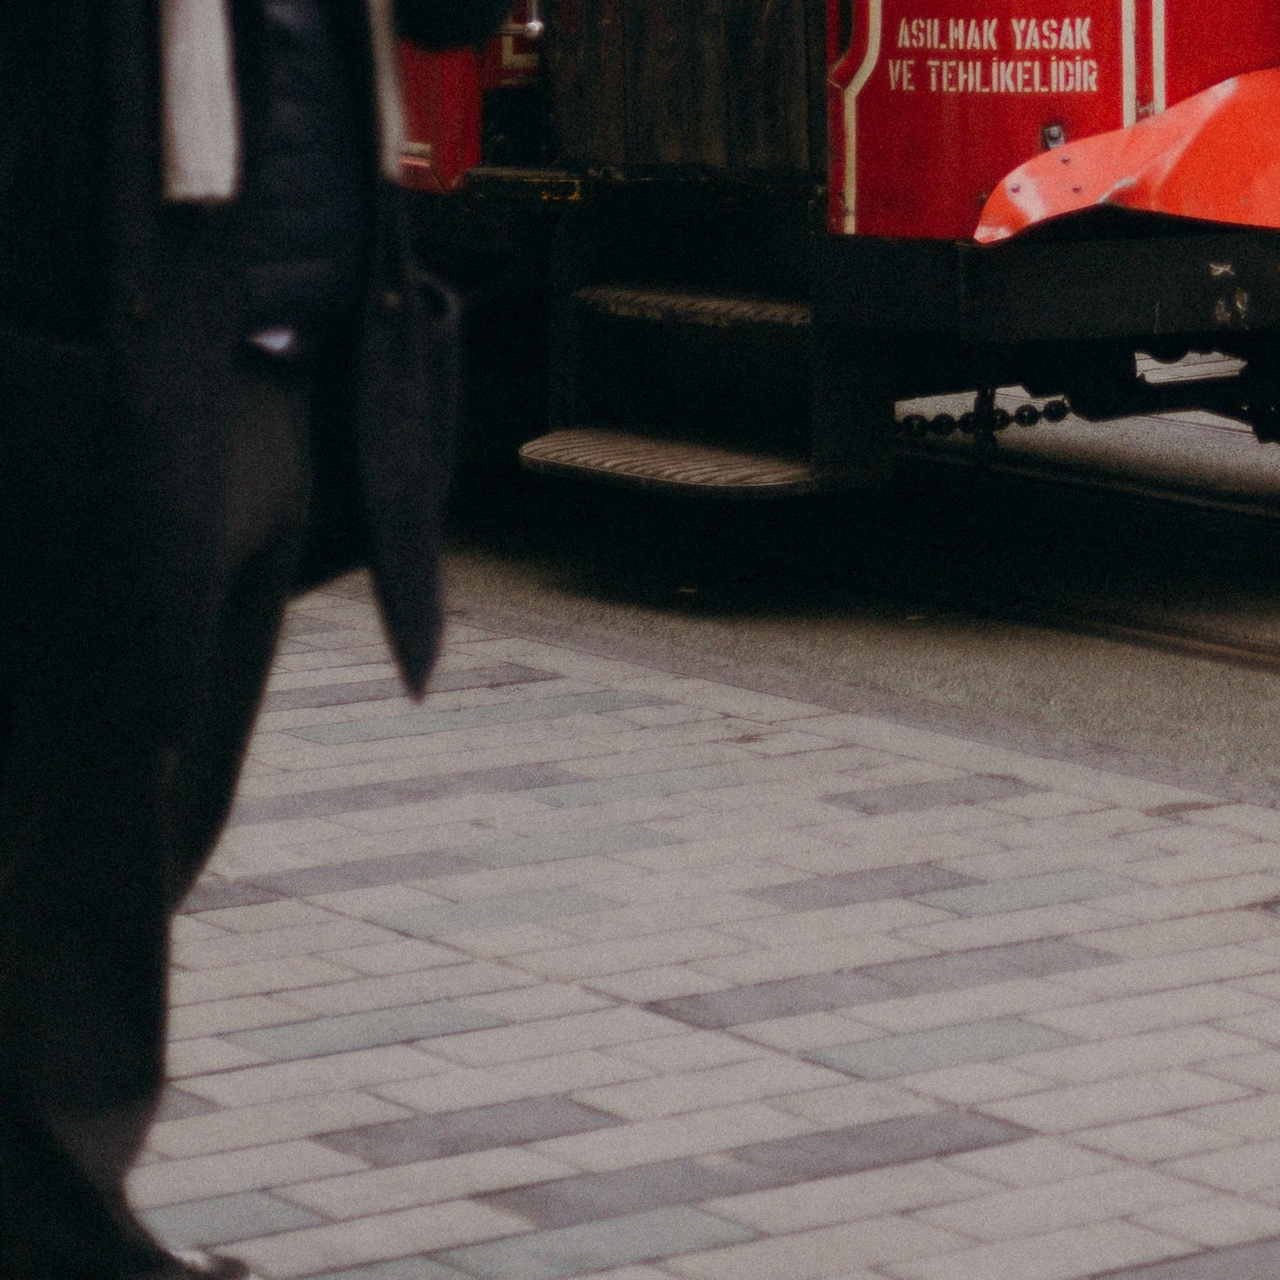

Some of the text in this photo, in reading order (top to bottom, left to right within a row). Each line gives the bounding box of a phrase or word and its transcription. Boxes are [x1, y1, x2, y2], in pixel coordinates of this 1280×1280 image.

[898, 17, 1091, 50] ASILMAK YASAK
[888, 56, 1098, 93] VE TEHLİKELİDİR
